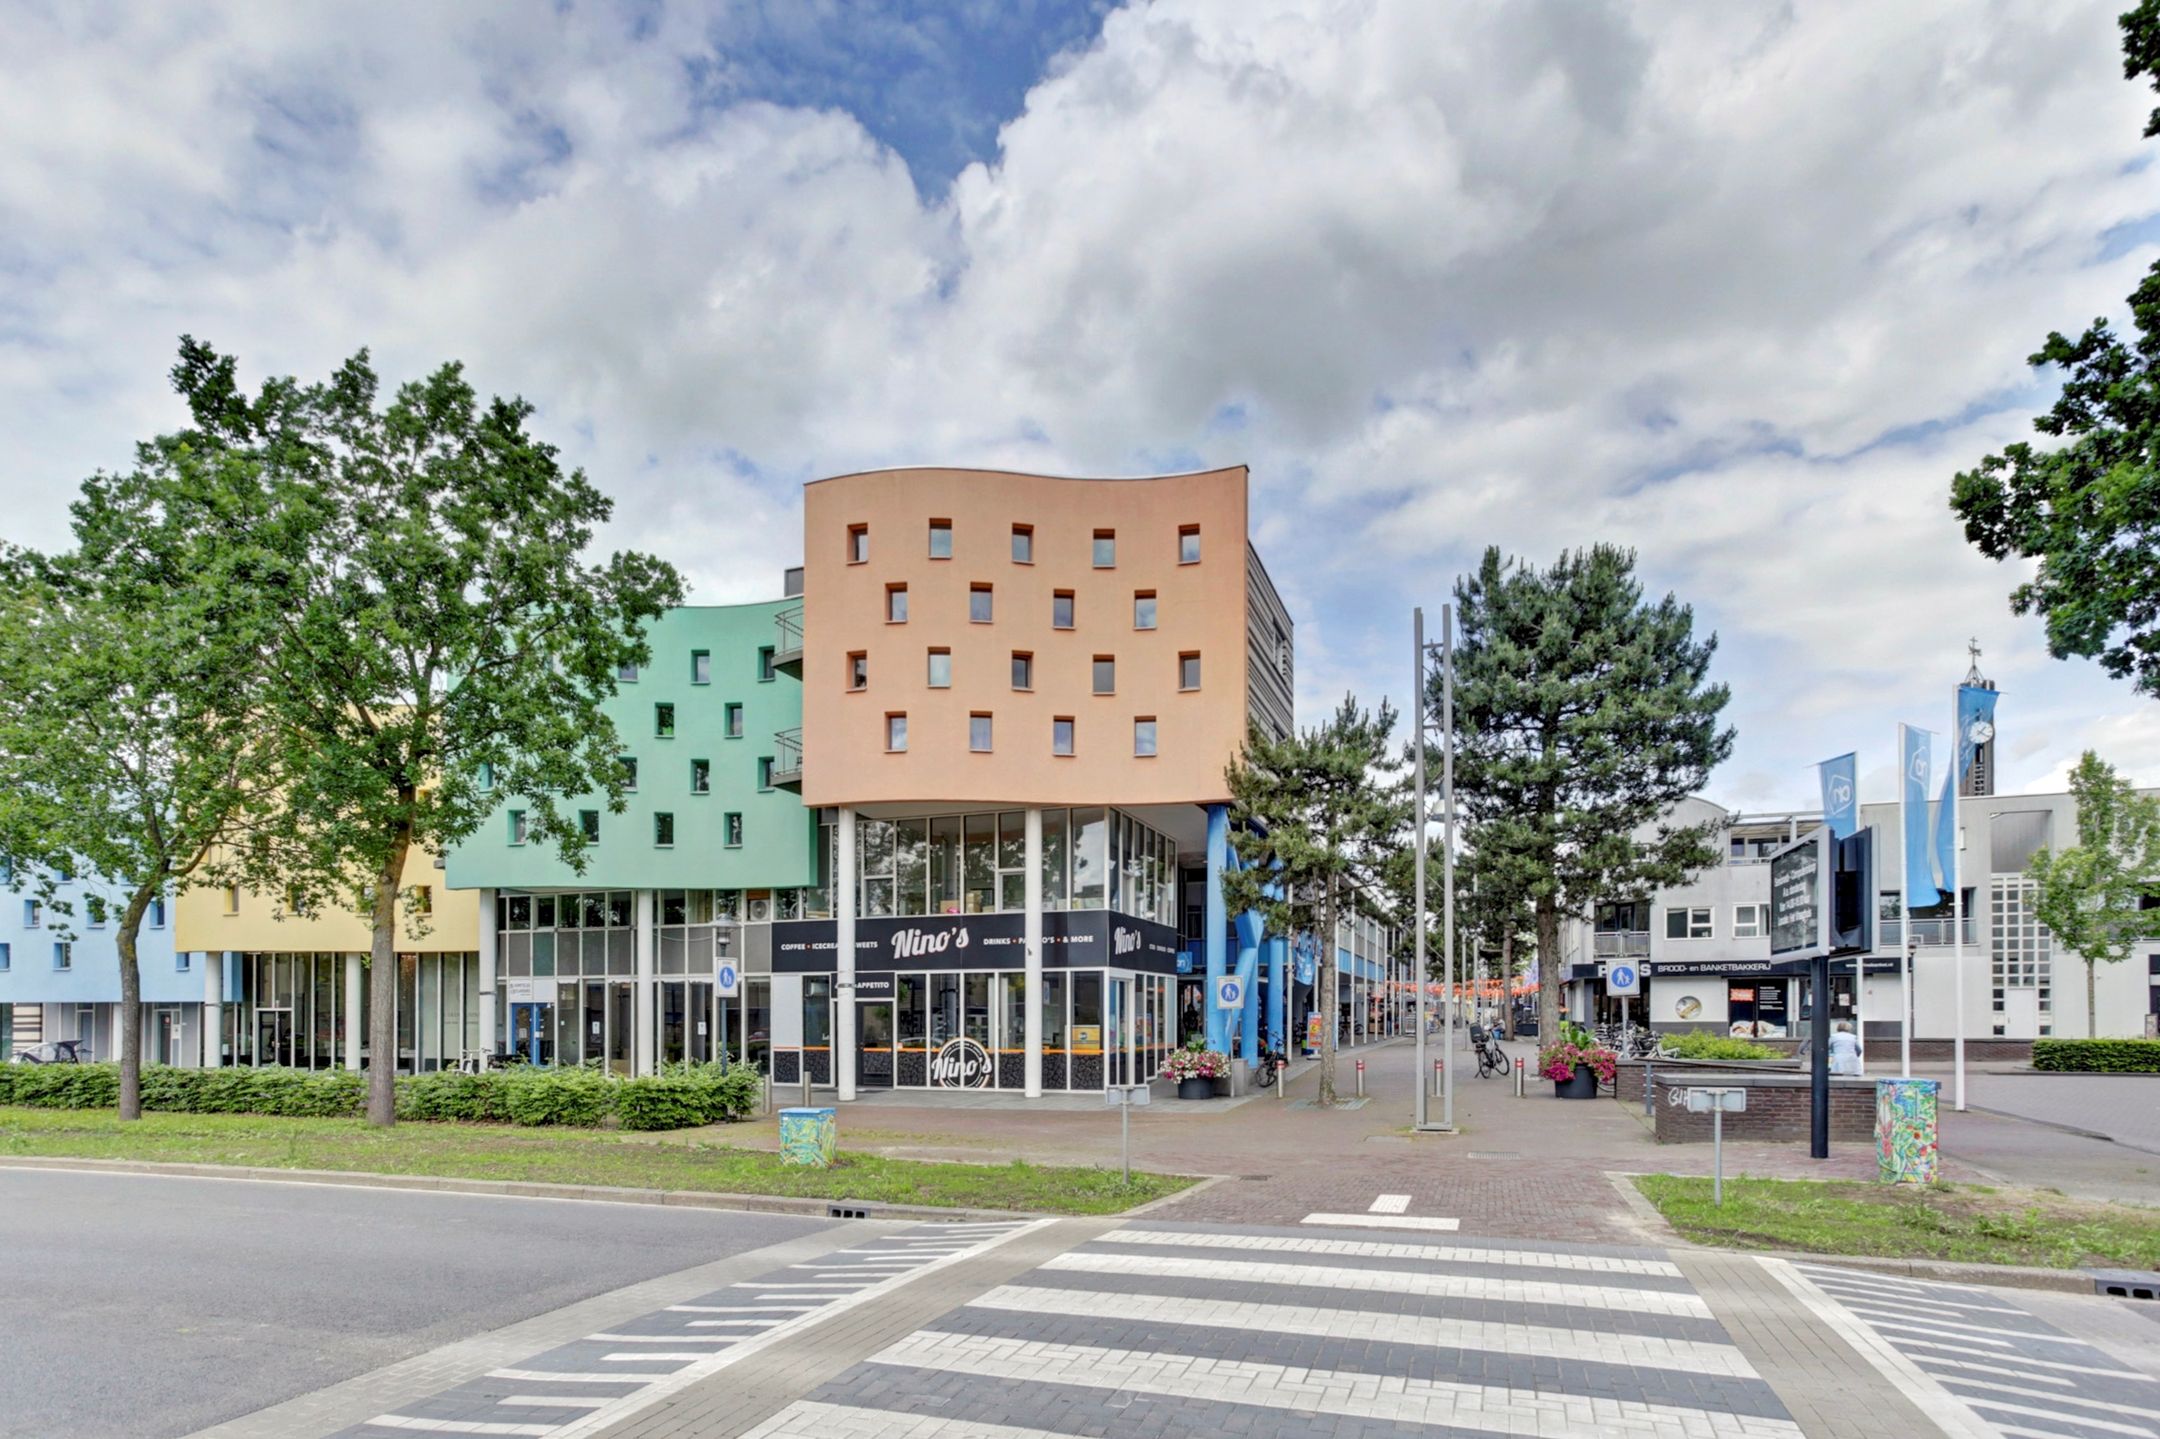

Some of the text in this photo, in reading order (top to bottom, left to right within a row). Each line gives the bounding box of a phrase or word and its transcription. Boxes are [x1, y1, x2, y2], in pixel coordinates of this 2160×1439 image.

[891, 927, 969, 959] Nino's
[1070, 935, 1094, 943] MORE
[1114, 926, 1141, 955] Nino's
[855, 941, 878, 949] WEETS
[1658, 964, 1687, 972] BROOD-
[1700, 963, 1771, 972] BANKETBAKKERIJ
[857, 981, 889, 989] APPETITO
[931, 1056, 992, 1080] Nino's
